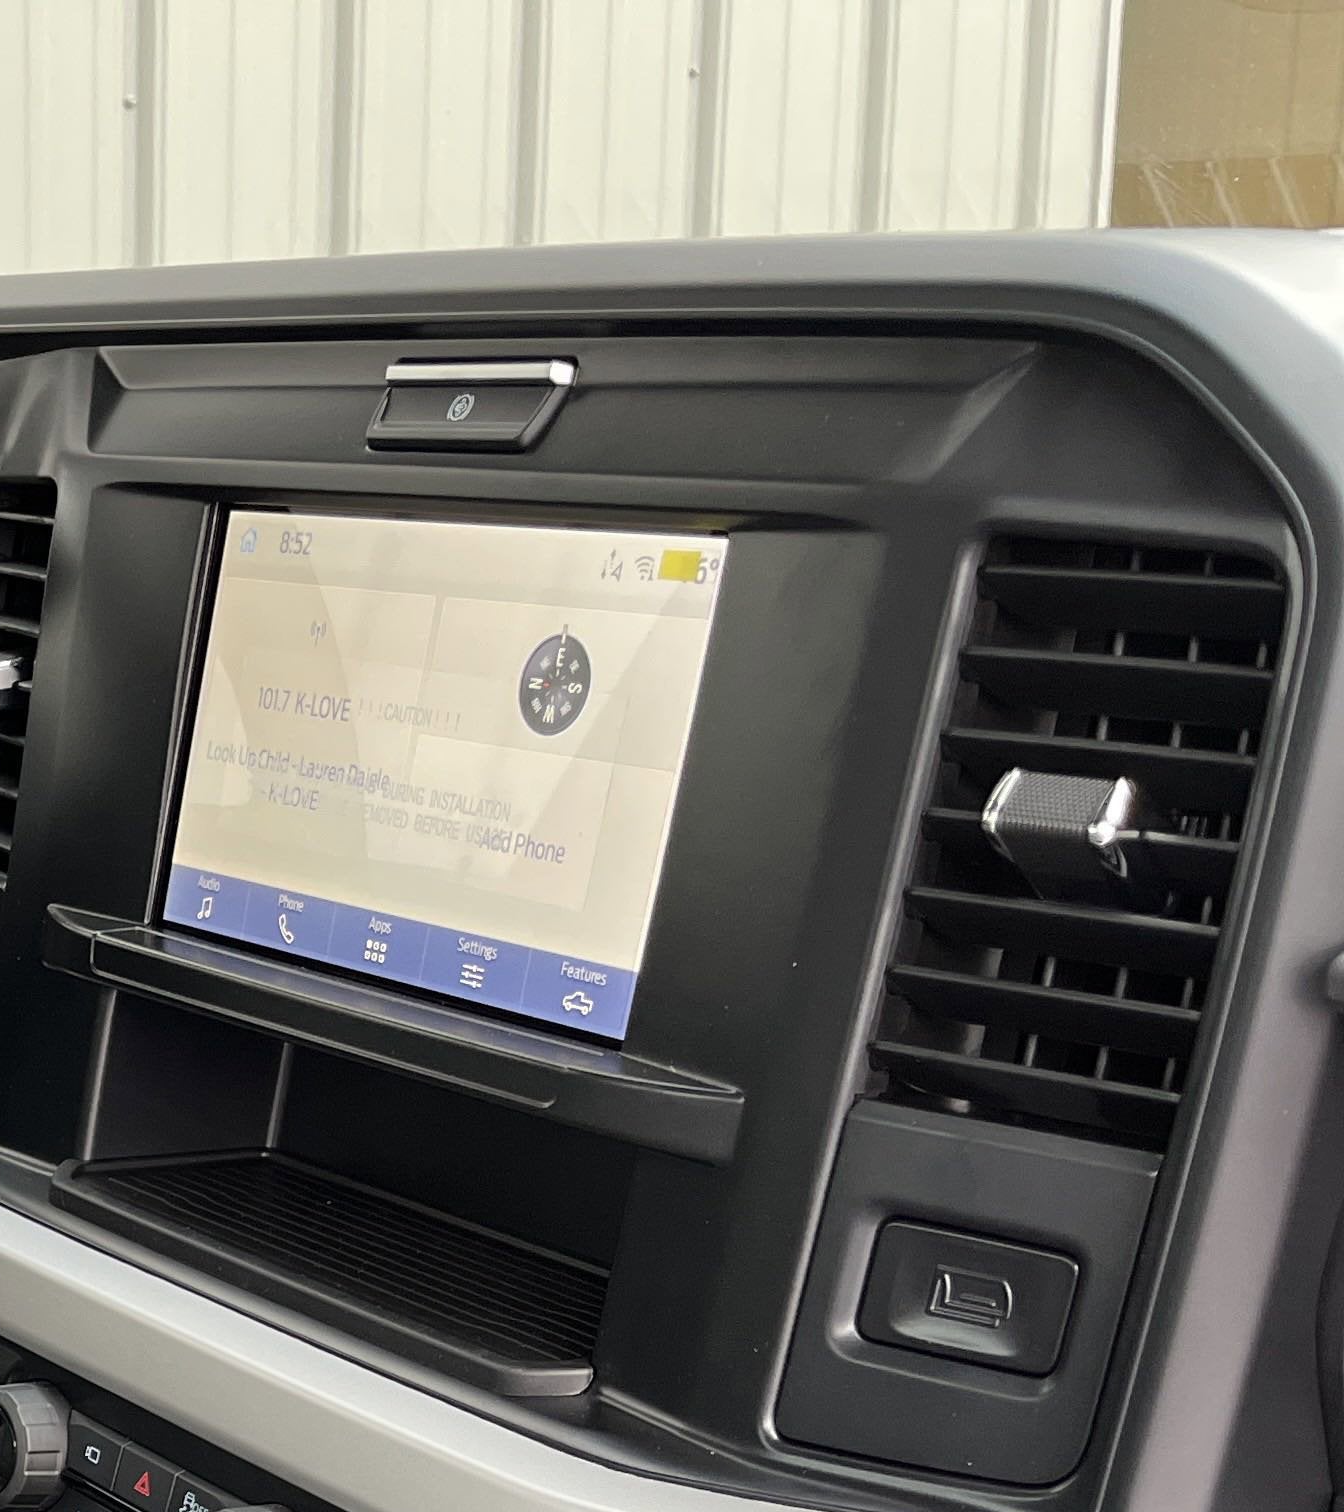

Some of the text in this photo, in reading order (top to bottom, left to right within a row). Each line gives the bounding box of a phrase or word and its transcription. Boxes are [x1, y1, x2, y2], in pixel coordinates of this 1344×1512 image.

[279, 530, 312, 556] 8:52
[555, 647, 567, 668] E
[528, 677, 544, 690] N
[567, 682, 583, 694] S
[258, 686, 352, 722] 101.7 K-LOVE
[542, 704, 555, 723] W
[206, 741, 236, 764] Look
[239, 745, 257, 768] Up
[258, 749, 289, 773] Child
[299, 755, 345, 783] Lauren
[348, 763, 392, 792] Daigle
[269, 783, 320, 811] K-LOVE
[358, 802, 409, 829] EMOVED
[479, 827, 566, 864] Add Phone
[198, 875, 221, 893] Audio
[278, 894, 304, 913] Phone
[368, 917, 392, 935] Apps
[457, 937, 498, 961] Settings
[560, 961, 608, 986] Features
